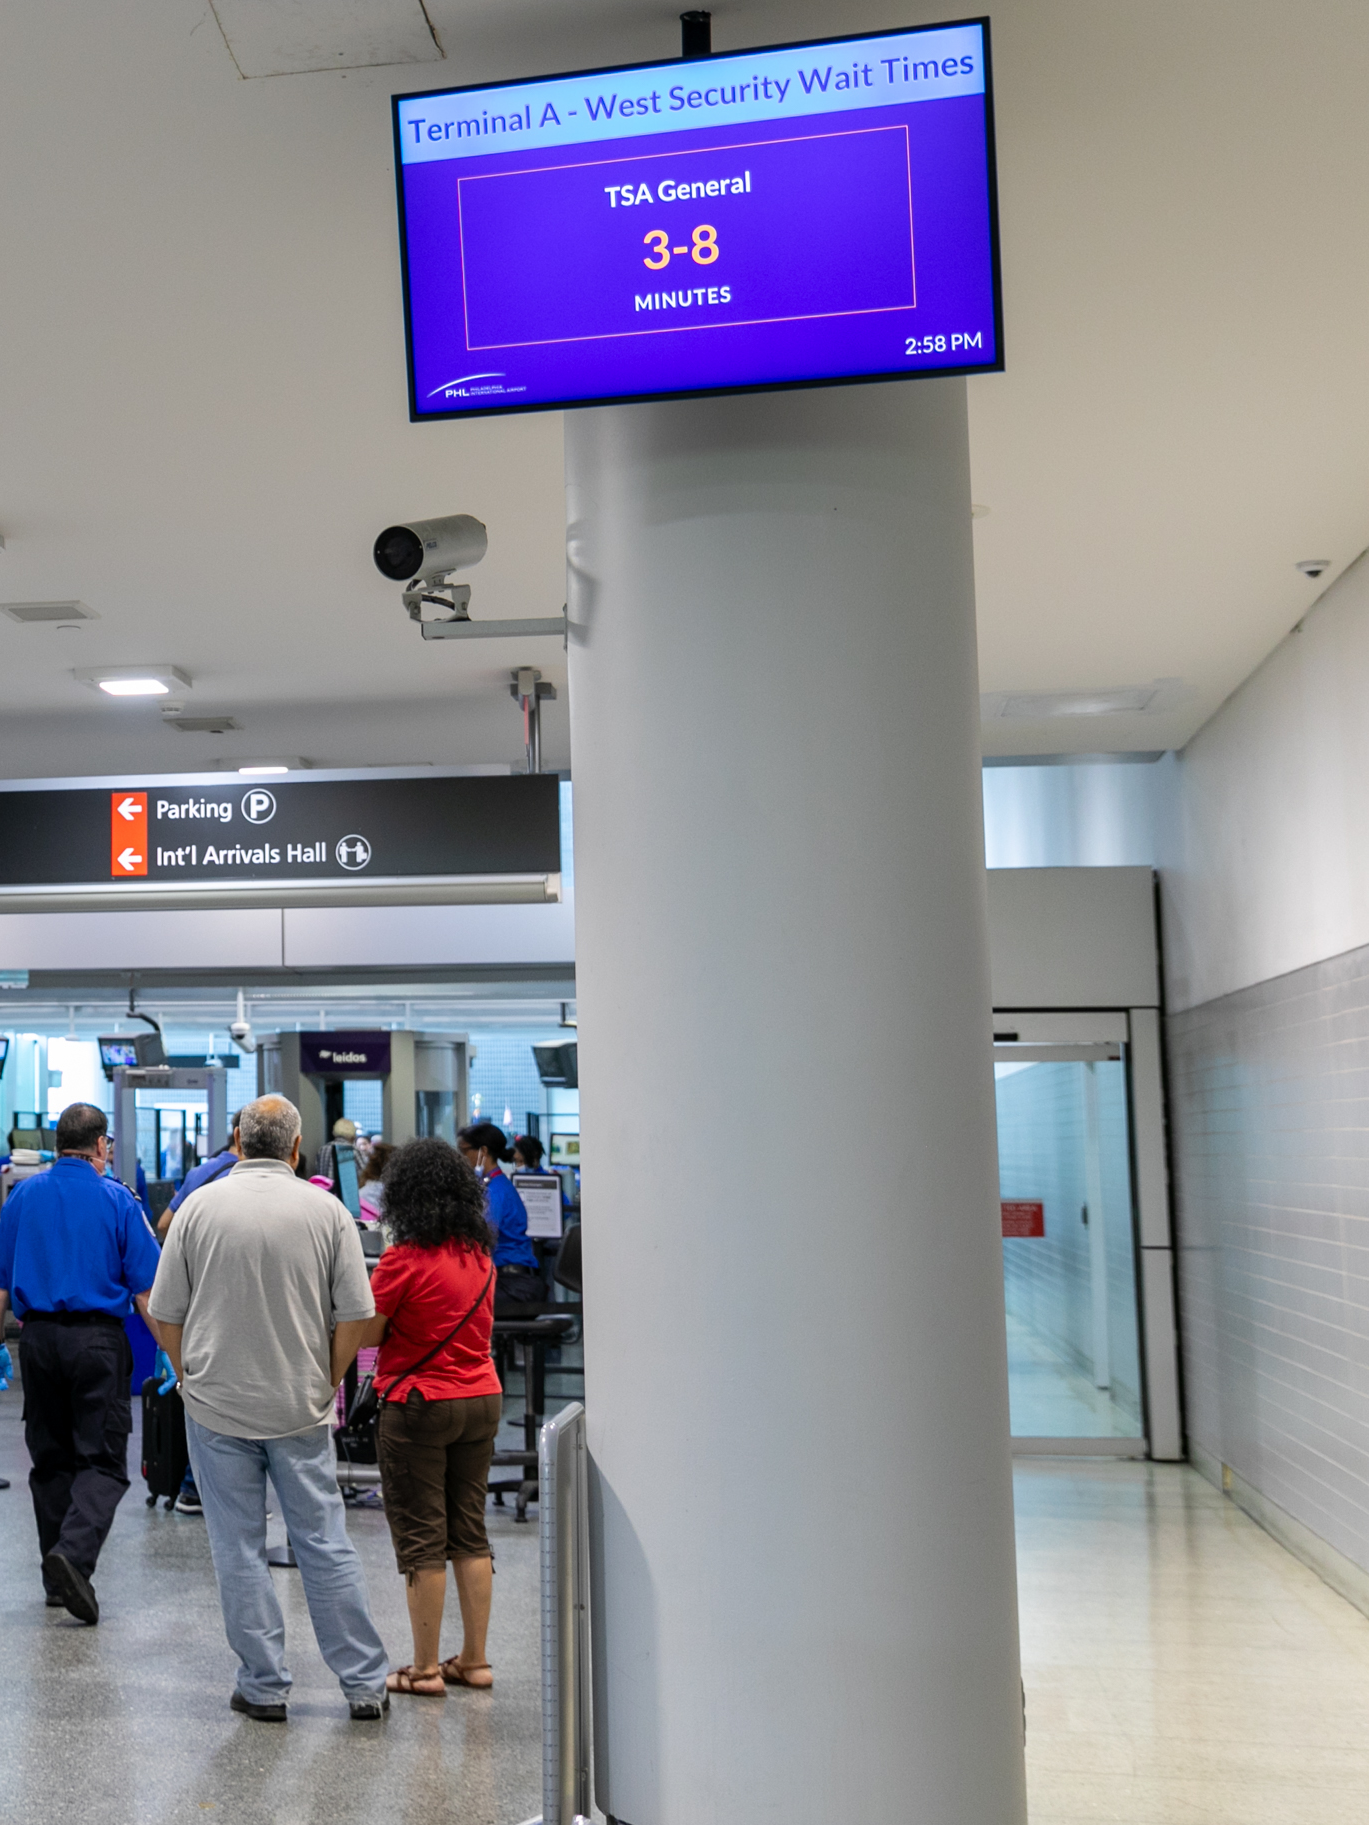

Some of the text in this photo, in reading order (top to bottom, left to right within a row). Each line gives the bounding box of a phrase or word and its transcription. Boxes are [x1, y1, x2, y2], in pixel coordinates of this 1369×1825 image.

[407, 103, 532, 144] Terminal
[539, 102, 561, 128] A
[583, 90, 662, 121] West
[668, 75, 791, 111] Security
[797, 62, 874, 94] Wait
[880, 54, 975, 84] Times
[604, 170, 752, 208] TSA General
[643, 224, 720, 270] 3-8
[634, 286, 732, 312] MINUTES
[905, 331, 982, 355] 2:58 PM
[445, 388, 470, 398] PHL
[156, 798, 233, 822] Parking
[156, 841, 327, 867] Int'l Arrivals Hall
[332, 1051, 368, 1064] leidos
